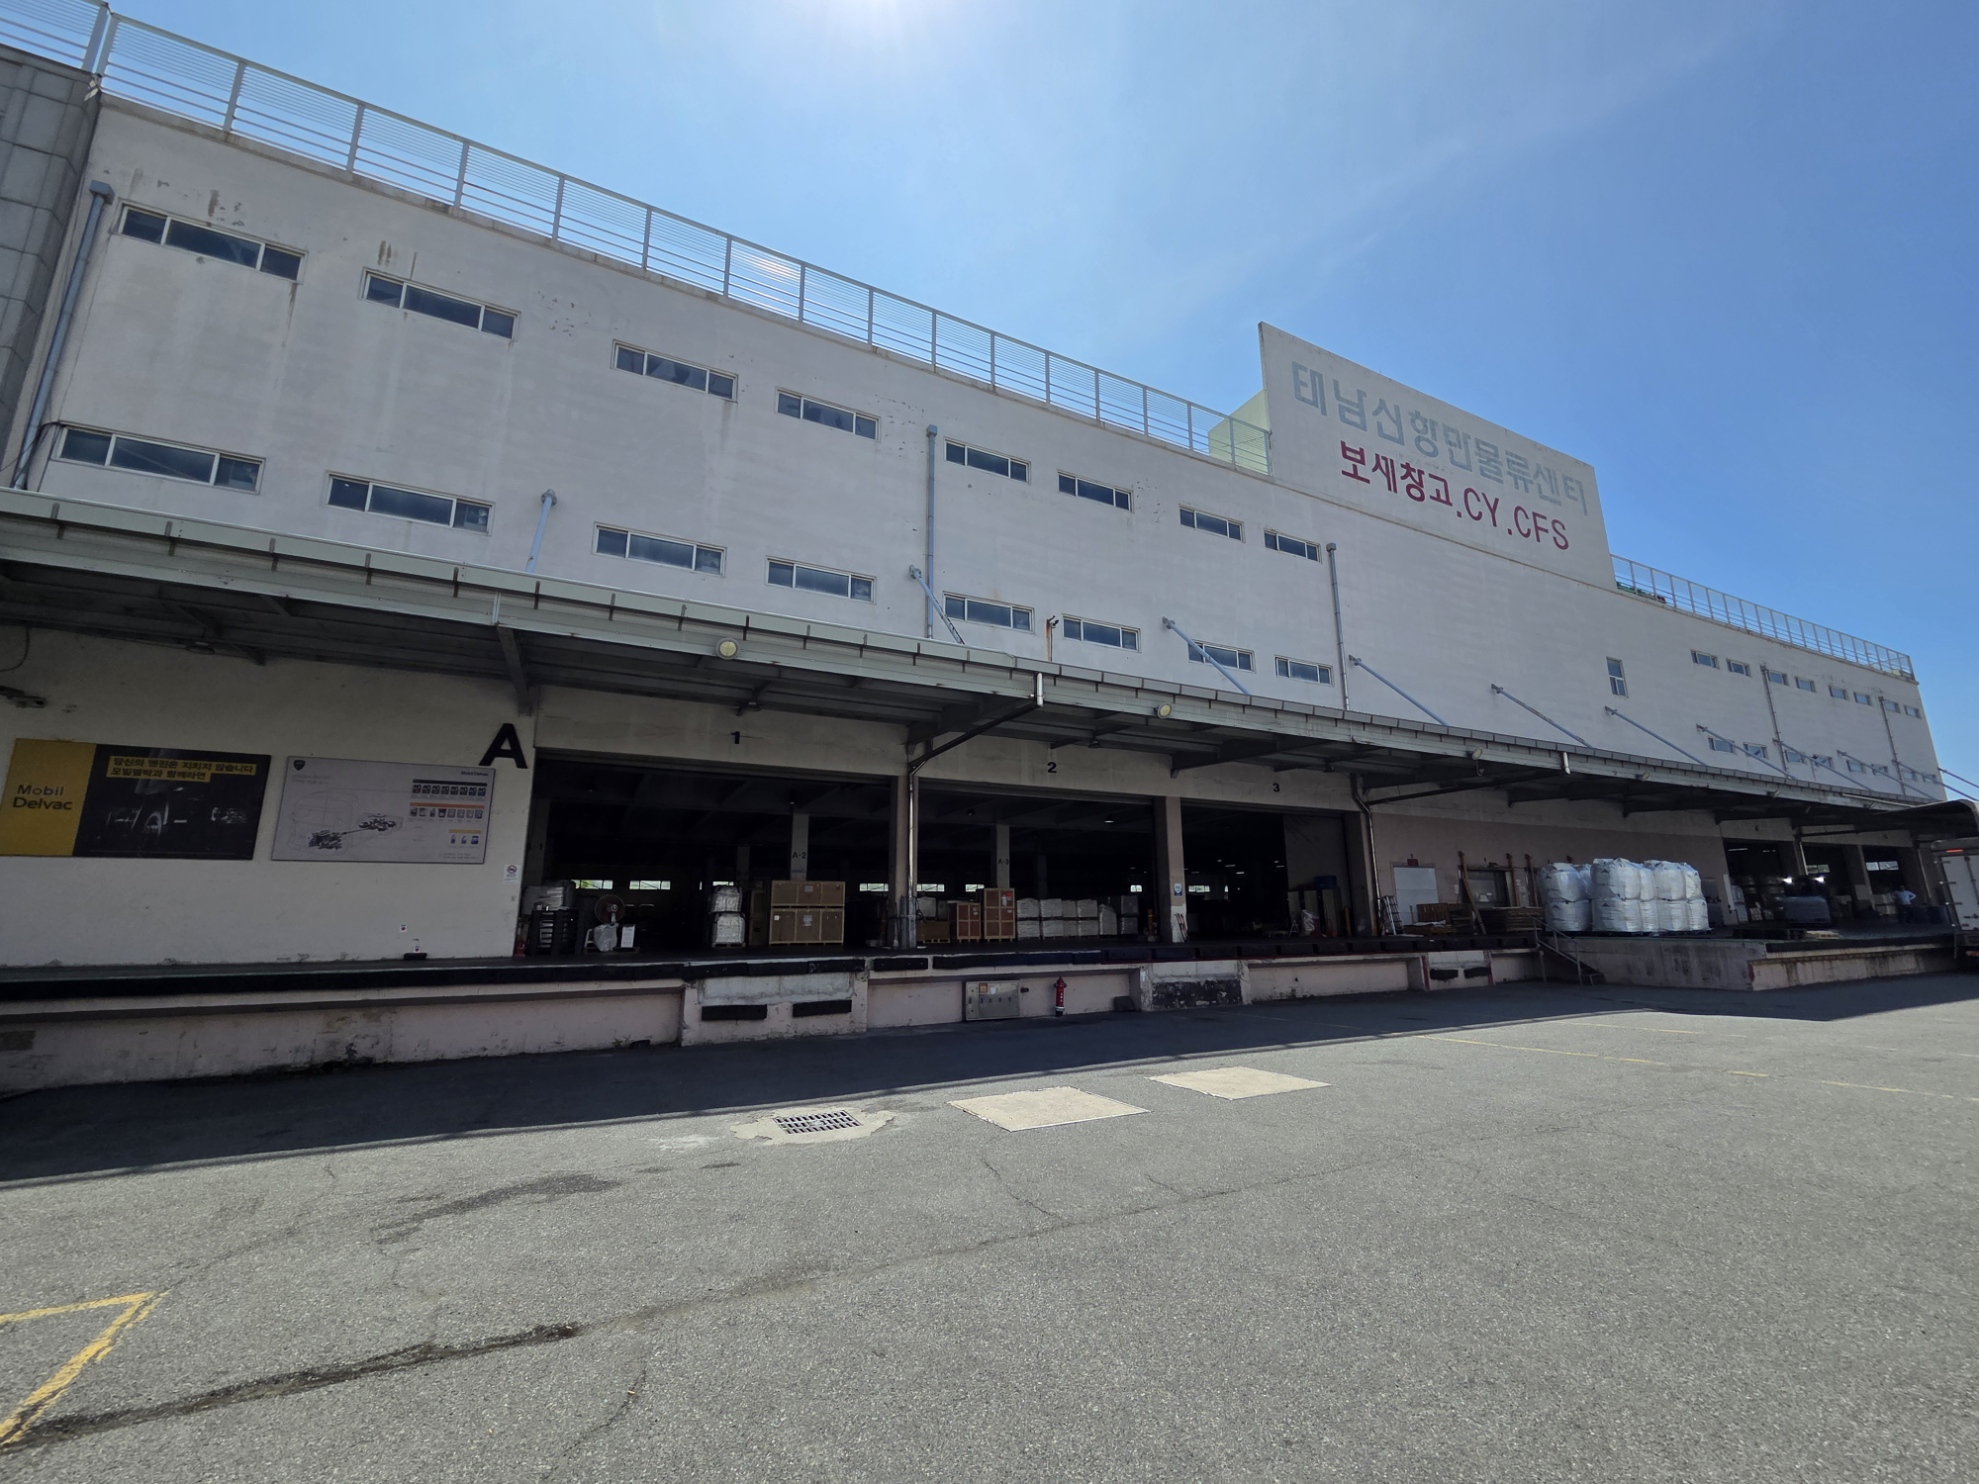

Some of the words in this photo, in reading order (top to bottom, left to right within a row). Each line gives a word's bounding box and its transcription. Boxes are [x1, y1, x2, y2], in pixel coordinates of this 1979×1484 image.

[730, 731, 740, 744] 1
[478, 723, 528, 769] A
[1047, 762, 1057, 773] 2
[17, 784, 64, 796] Mobil
[1272, 783, 1281, 793] 3
[12, 796, 73, 810] Delvac
[792, 851, 807, 859] A-2
